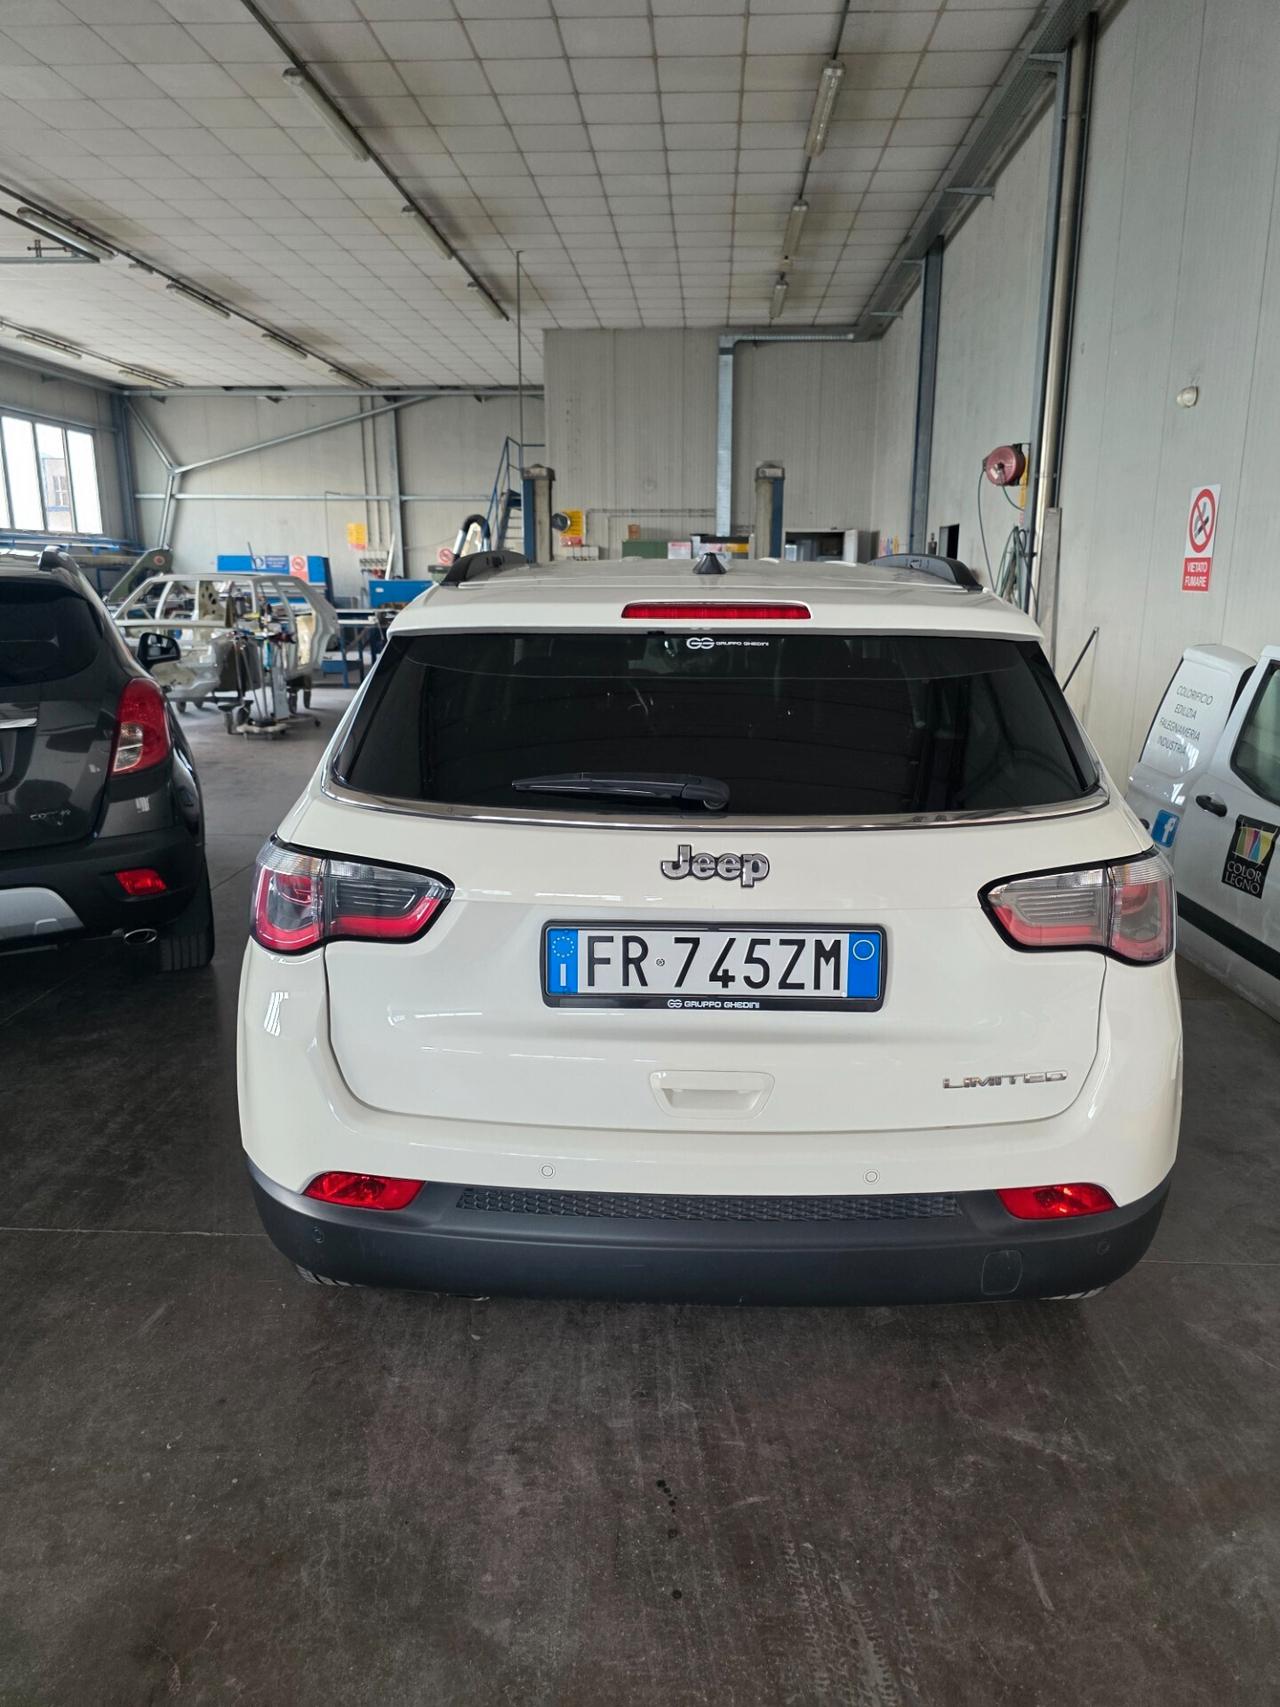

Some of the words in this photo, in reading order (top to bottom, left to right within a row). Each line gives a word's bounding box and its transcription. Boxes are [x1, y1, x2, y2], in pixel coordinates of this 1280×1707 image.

[1186, 561, 1209, 573] VIETATO
[1184, 575, 1208, 588] FUMARE
[1176, 685, 1214, 706] COLORIFICIO
[1174, 703, 1197, 720] EDILIZIA
[1160, 716, 1200, 741] FALEGNAMERIA
[661, 844, 770, 888] Jeep
[1227, 861, 1262, 884] COLOR
[1224, 871, 1260, 894] LEGNO
[684, 1000, 722, 1008] GRUPPO
[723, 1001, 760, 1009] GHEDINI
[943, 1069, 1068, 1089] LIMITED
